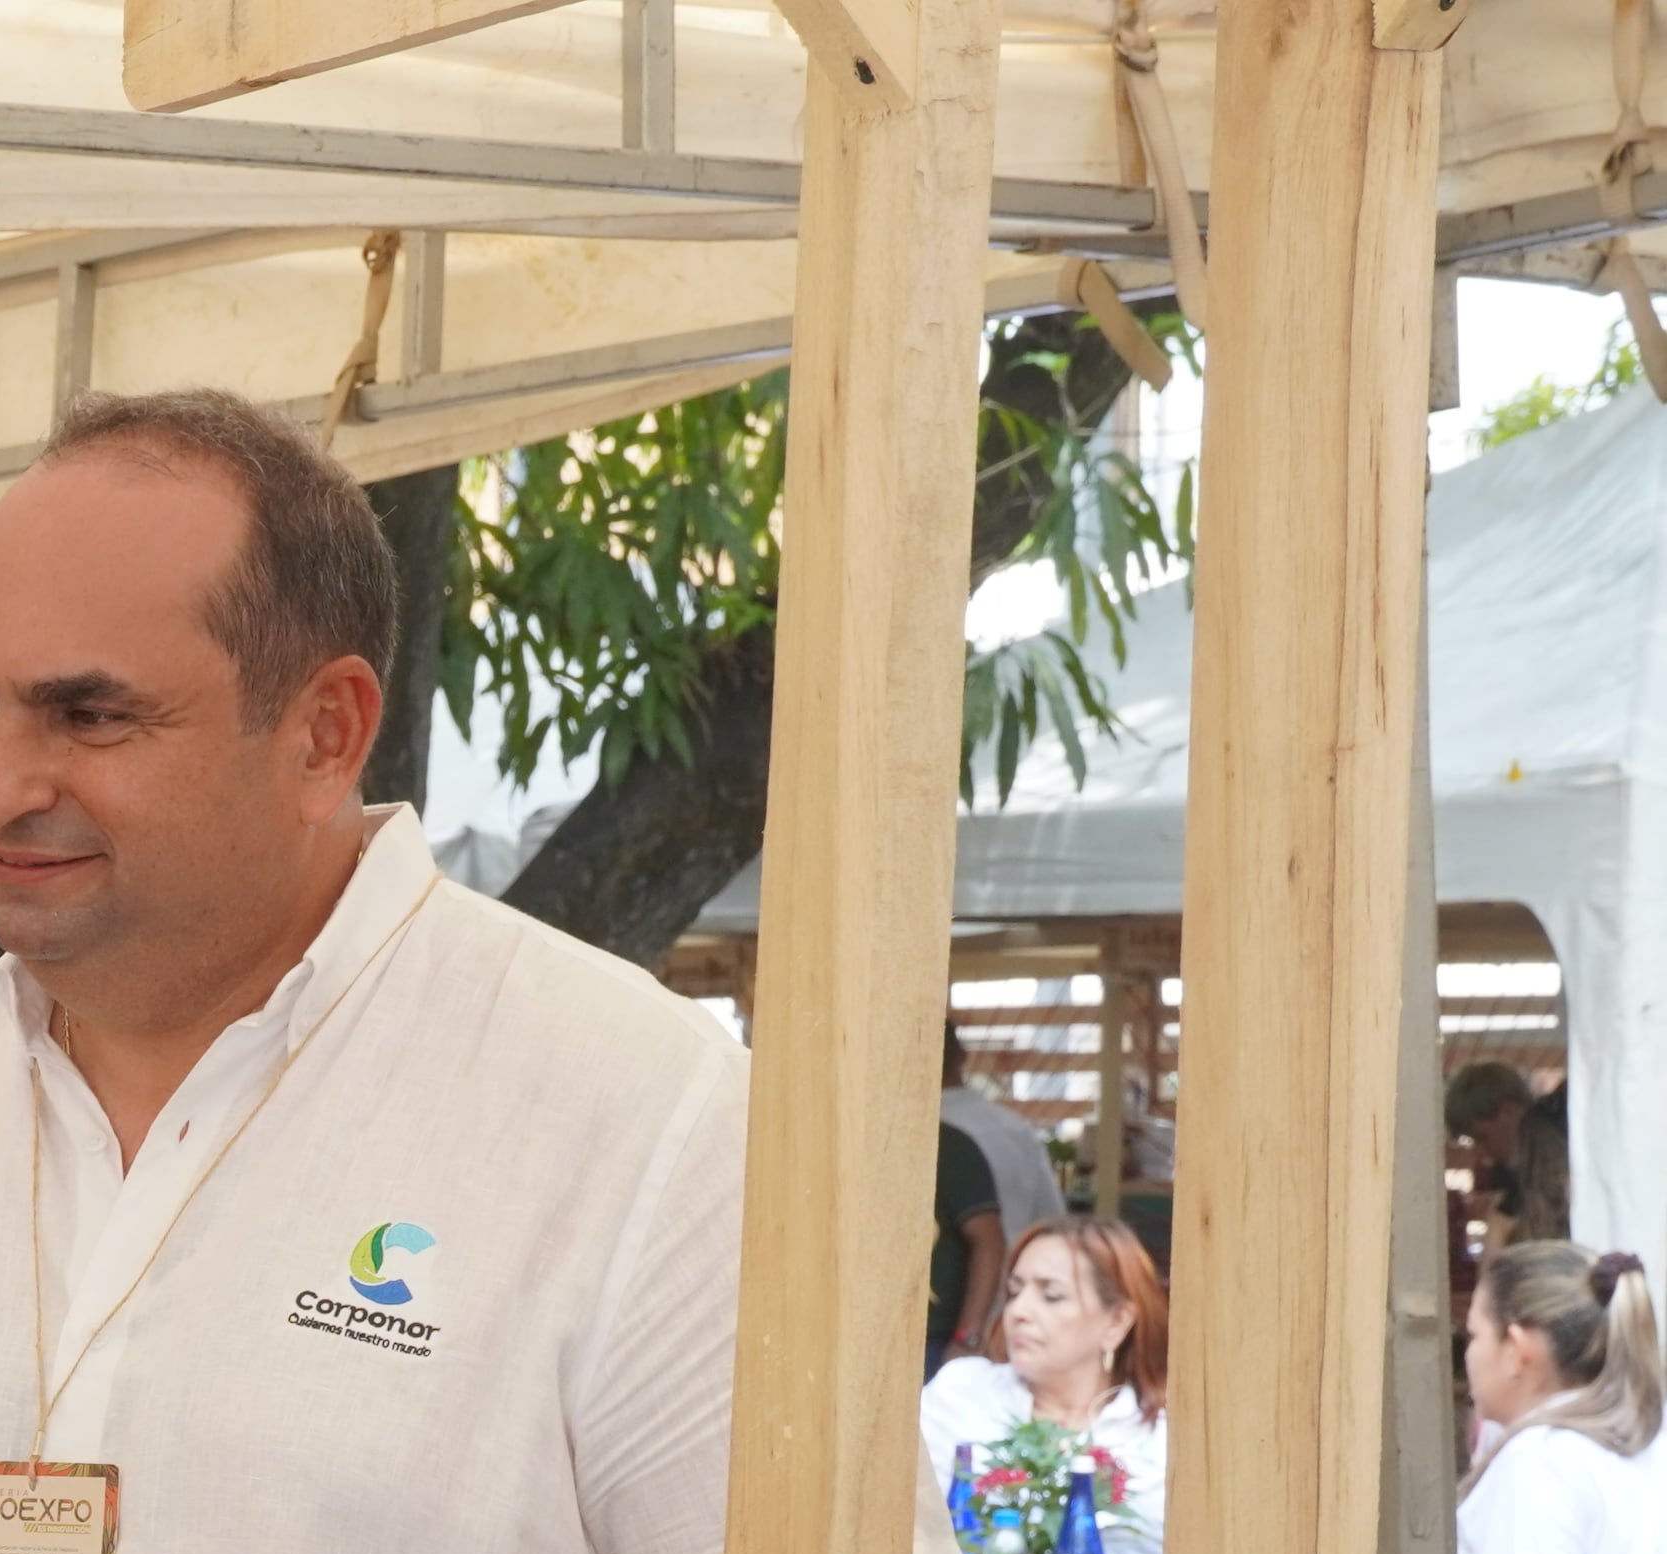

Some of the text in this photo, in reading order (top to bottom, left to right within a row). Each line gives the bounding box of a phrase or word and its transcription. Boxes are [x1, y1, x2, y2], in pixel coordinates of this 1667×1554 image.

[288, 1312, 431, 1358] Cuidamos nuestro mundo
[295, 1290, 441, 1341] Corponor
